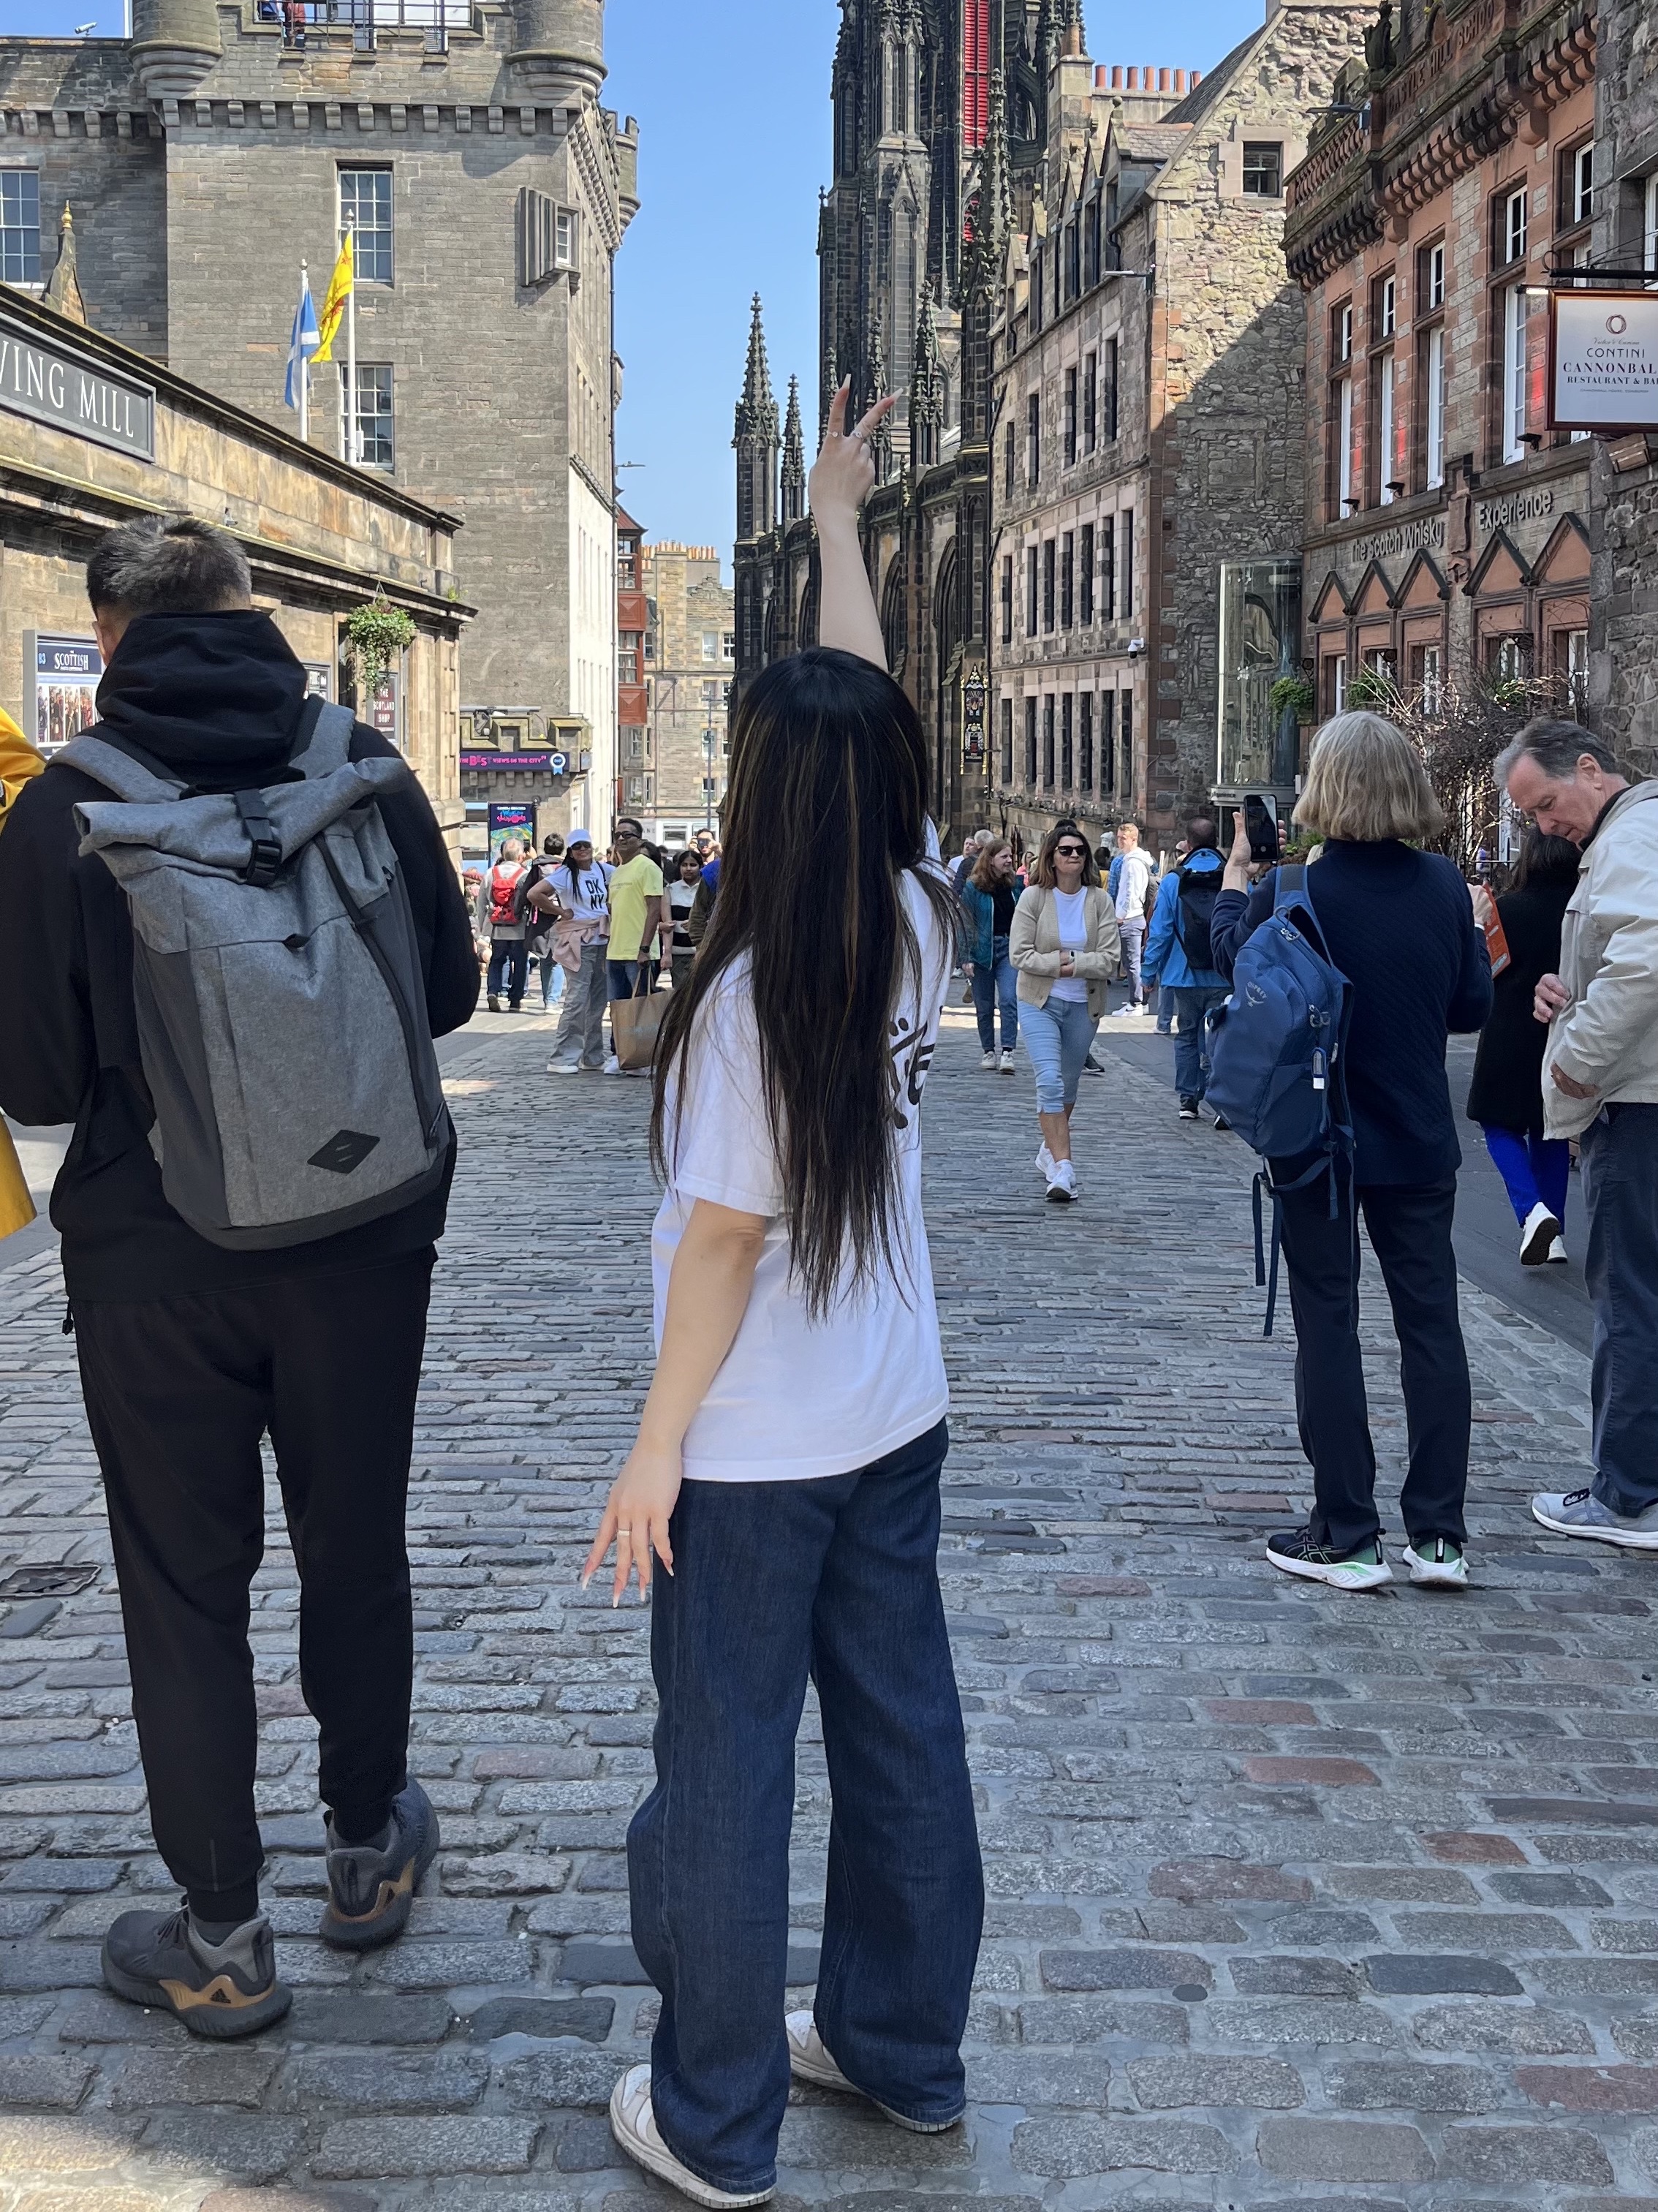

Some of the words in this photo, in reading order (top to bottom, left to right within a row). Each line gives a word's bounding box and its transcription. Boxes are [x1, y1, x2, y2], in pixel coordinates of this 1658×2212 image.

[1430, 39, 1453, 78] HILL
[1586, 347, 1645, 358] CONTINI
[1563, 362, 1657, 374] CANNONBAL
[1567, 376, 1629, 385] RESTAURANT
[1633, 377, 1640, 385] &
[80, 376, 133, 437] MILL
[1351, 538, 1366, 562] The
[1368, 527, 1401, 559] Scotch
[1404, 517, 1443, 548] Whisky
[1476, 490, 1553, 533] Experience
[54, 652, 89, 671] SCOTTISH
[373, 701, 395, 711] SCOTLAND
[585, 878, 604, 894] DK
[590, 894, 605, 910] NY
